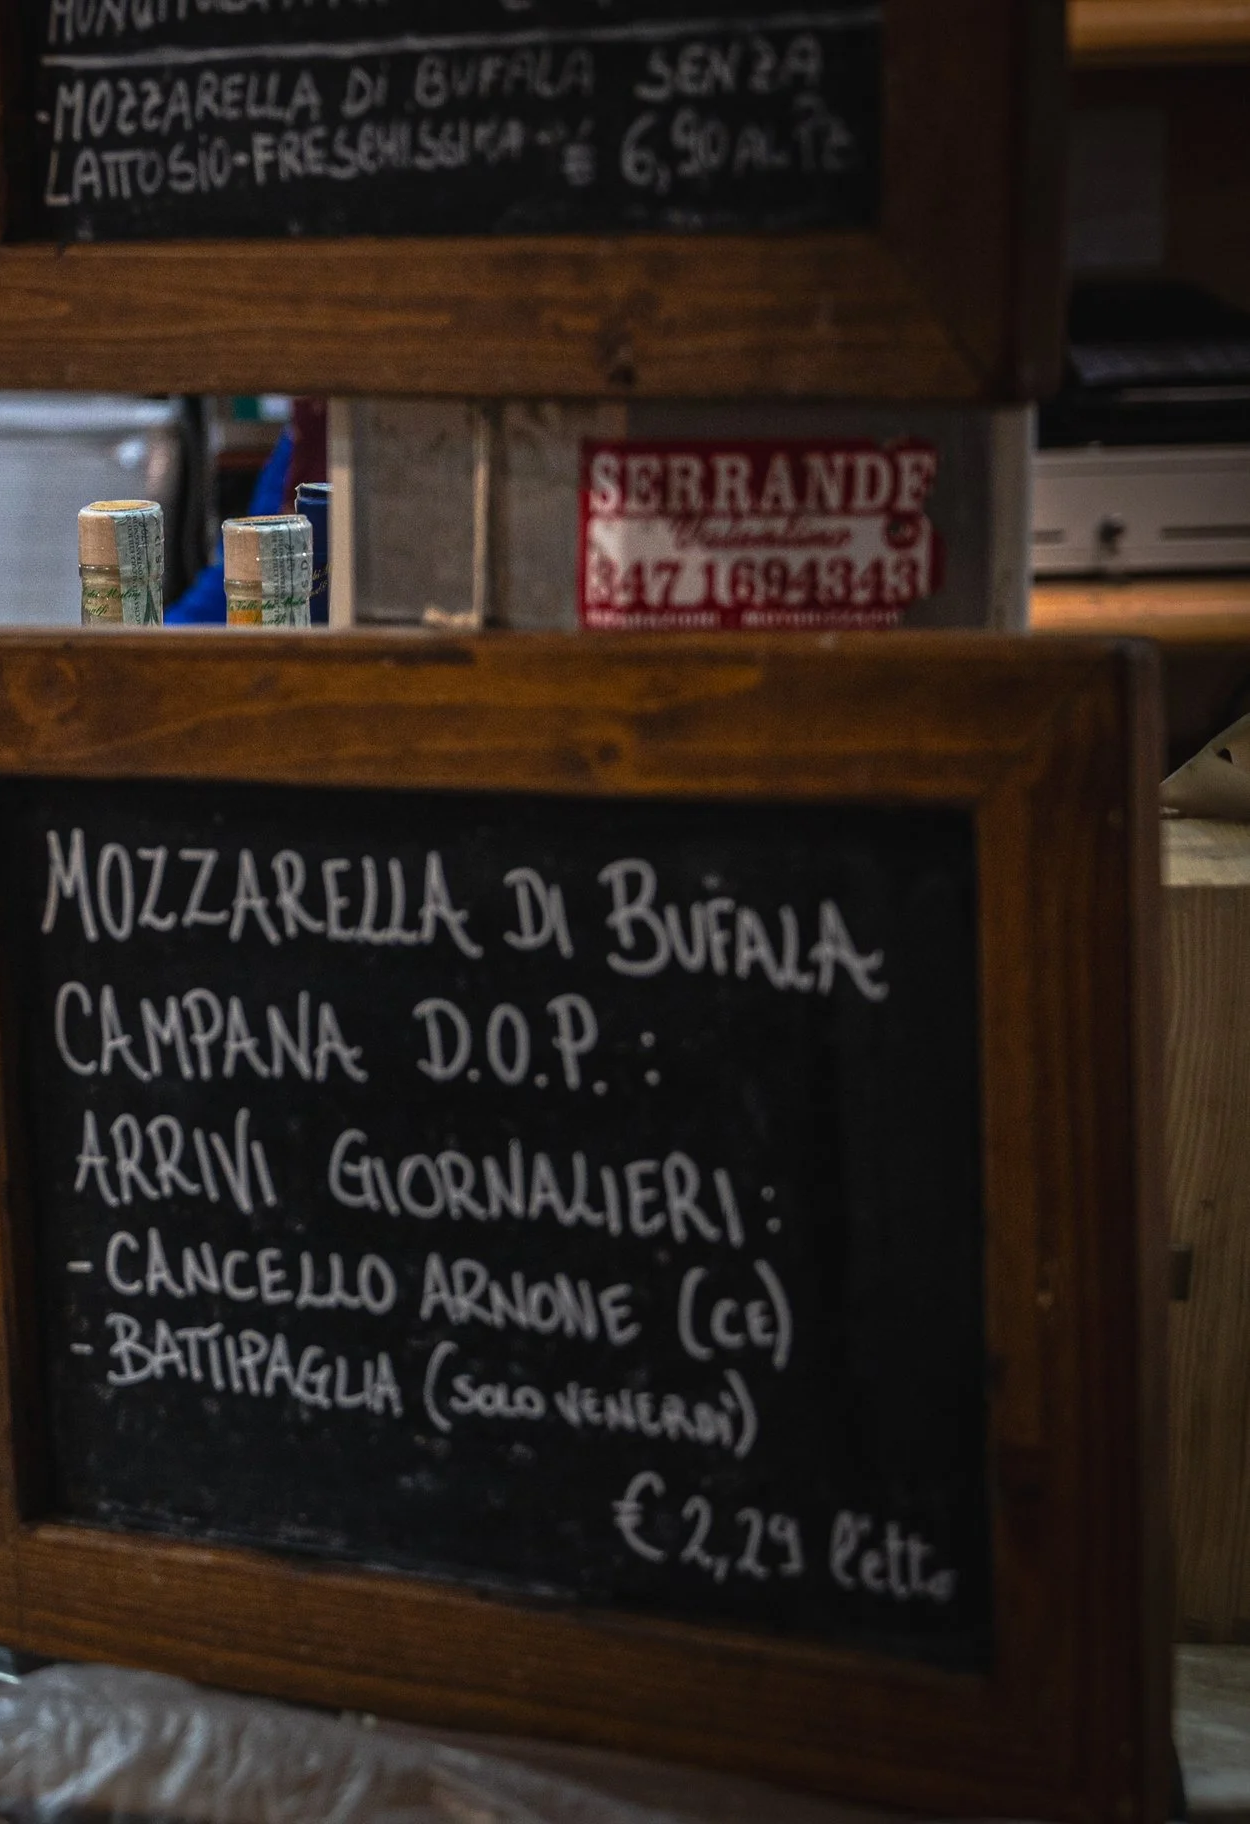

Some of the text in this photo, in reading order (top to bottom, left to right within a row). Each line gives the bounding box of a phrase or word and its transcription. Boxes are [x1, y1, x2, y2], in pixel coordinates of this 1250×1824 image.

[53, 66, 322, 143] MOZZARELLA
[414, 47, 597, 111] BUFALA
[634, 35, 825, 104] SENZA
[588, 450, 938, 514] SERRANDE
[41, 827, 890, 1001] MOZZARELLA DI BUFALA
[54, 981, 369, 1083] CAMPANA
[74, 1106, 278, 1215] ARRIVI
[104, 1228, 398, 1314] CANCELLO
[419, 1251, 643, 1348] ARNONE
[676, 1258, 796, 1370] (CE)
[104, 1311, 404, 1418] BATTIPAGLIA
[422, 1339, 547, 1433] (SOLO
[612, 1471, 666, 1563] €
[680, 1495, 806, 1584] 2,29
